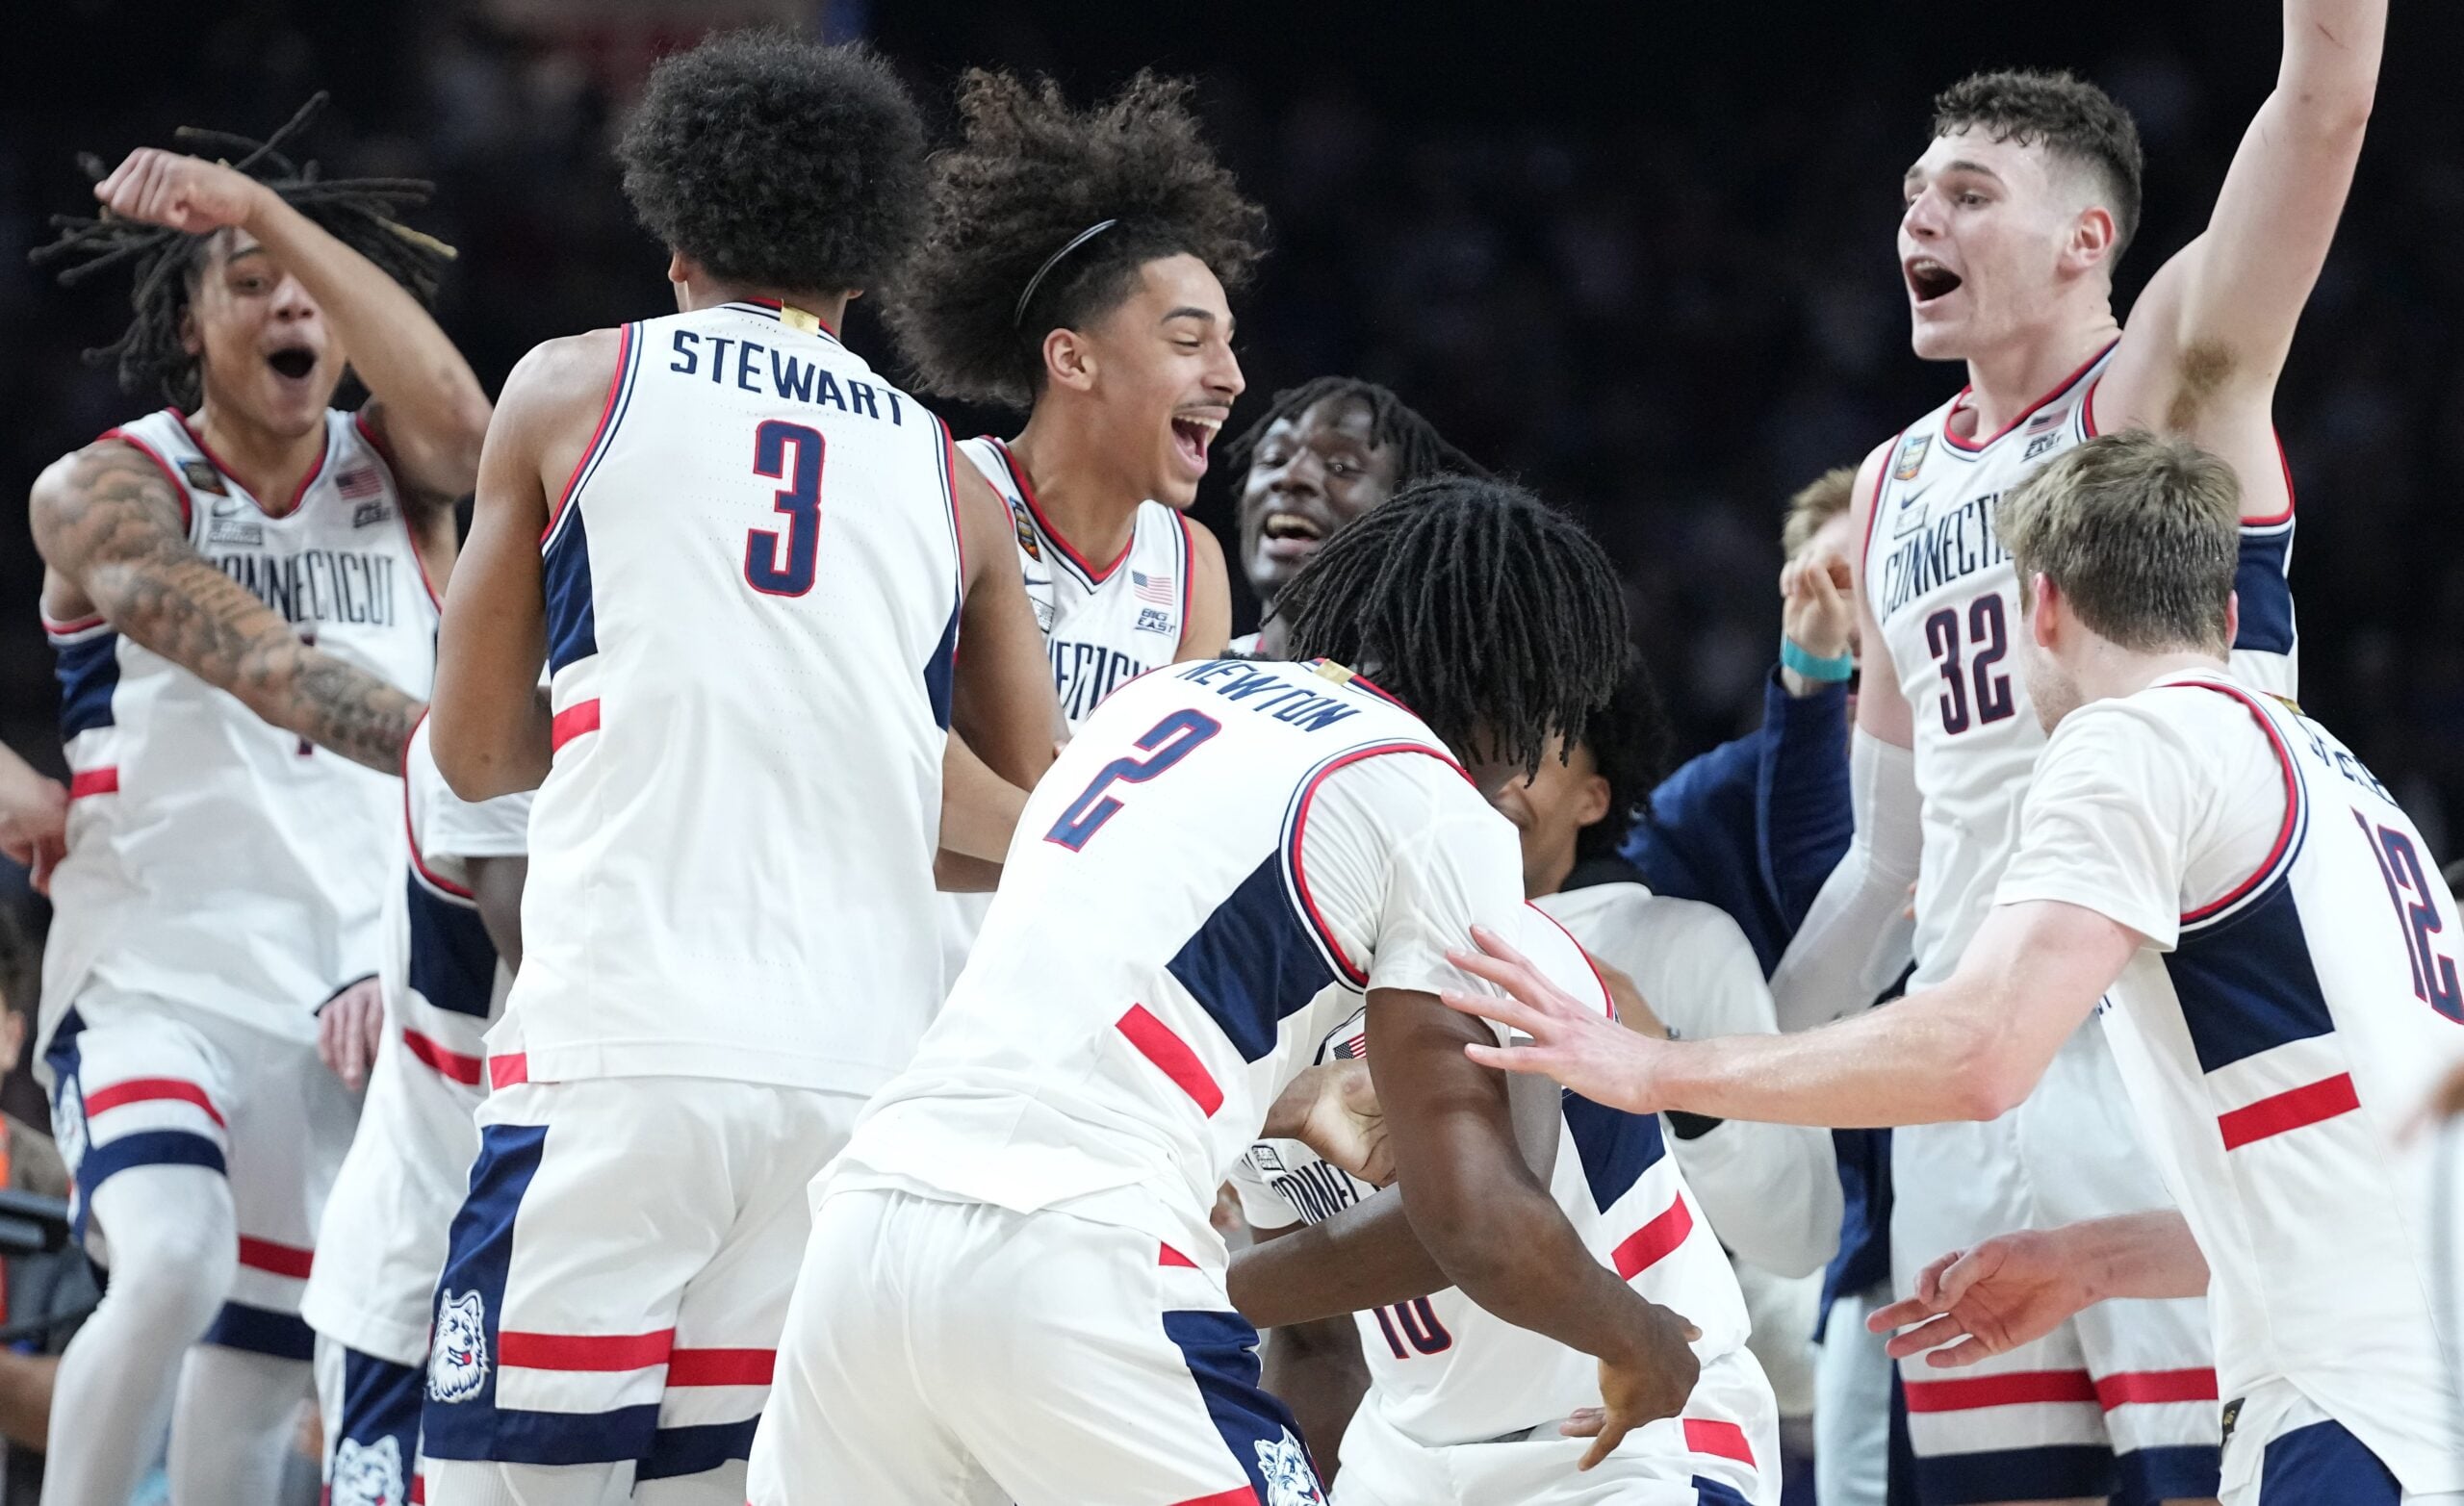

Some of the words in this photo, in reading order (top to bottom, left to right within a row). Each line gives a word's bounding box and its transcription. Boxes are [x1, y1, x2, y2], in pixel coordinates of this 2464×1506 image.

[670, 330, 903, 426] STEWART
[744, 419, 826, 598] 3
[1883, 493, 2015, 624] CONNECT
[1174, 659, 1363, 733] NEWTON
[1925, 592, 2015, 736] 32
[1043, 708, 1222, 853] 2
[2350, 805, 2464, 1026] 12
